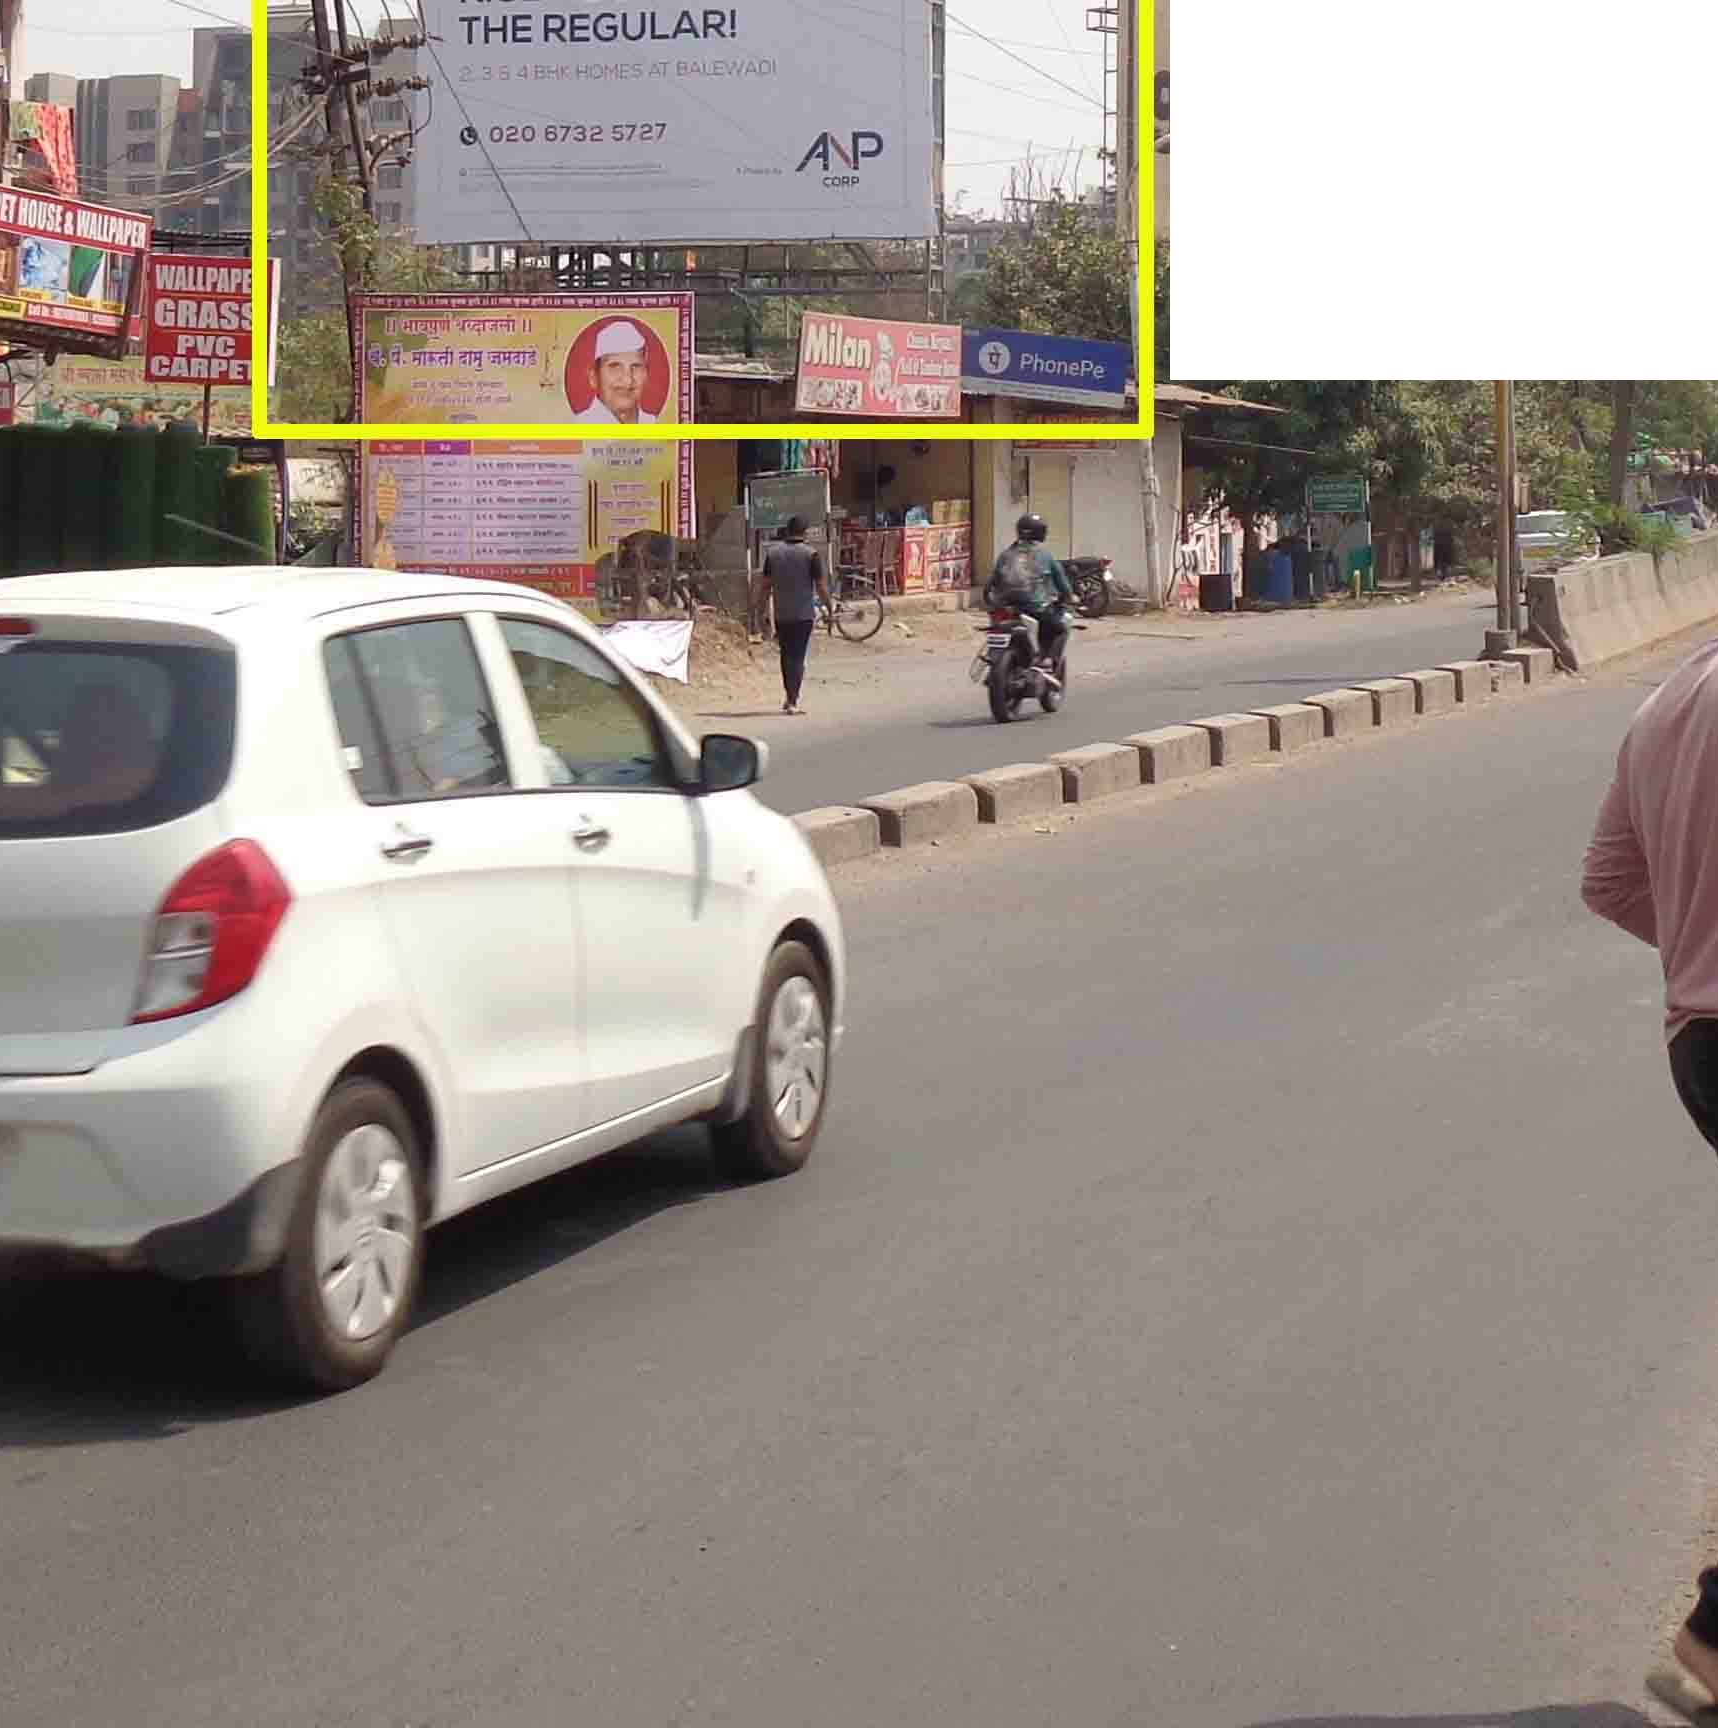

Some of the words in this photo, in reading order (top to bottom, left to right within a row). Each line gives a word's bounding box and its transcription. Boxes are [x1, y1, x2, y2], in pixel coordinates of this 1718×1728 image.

[459, 14, 534, 46] THE
[543, 9, 738, 43] REGULAR!
[489, 126, 535, 144] 020
[544, 124, 604, 143] 6732
[611, 122, 667, 142] 5727
[822, 175, 860, 188] CORP
[19, 193, 61, 235] HOUSE
[63, 206, 75, 235] &
[76, 207, 147, 249] WALLPAPER
[177, 335, 236, 357] PVC
[804, 321, 871, 369] Milan
[1019, 352, 1105, 379] PhonePe
